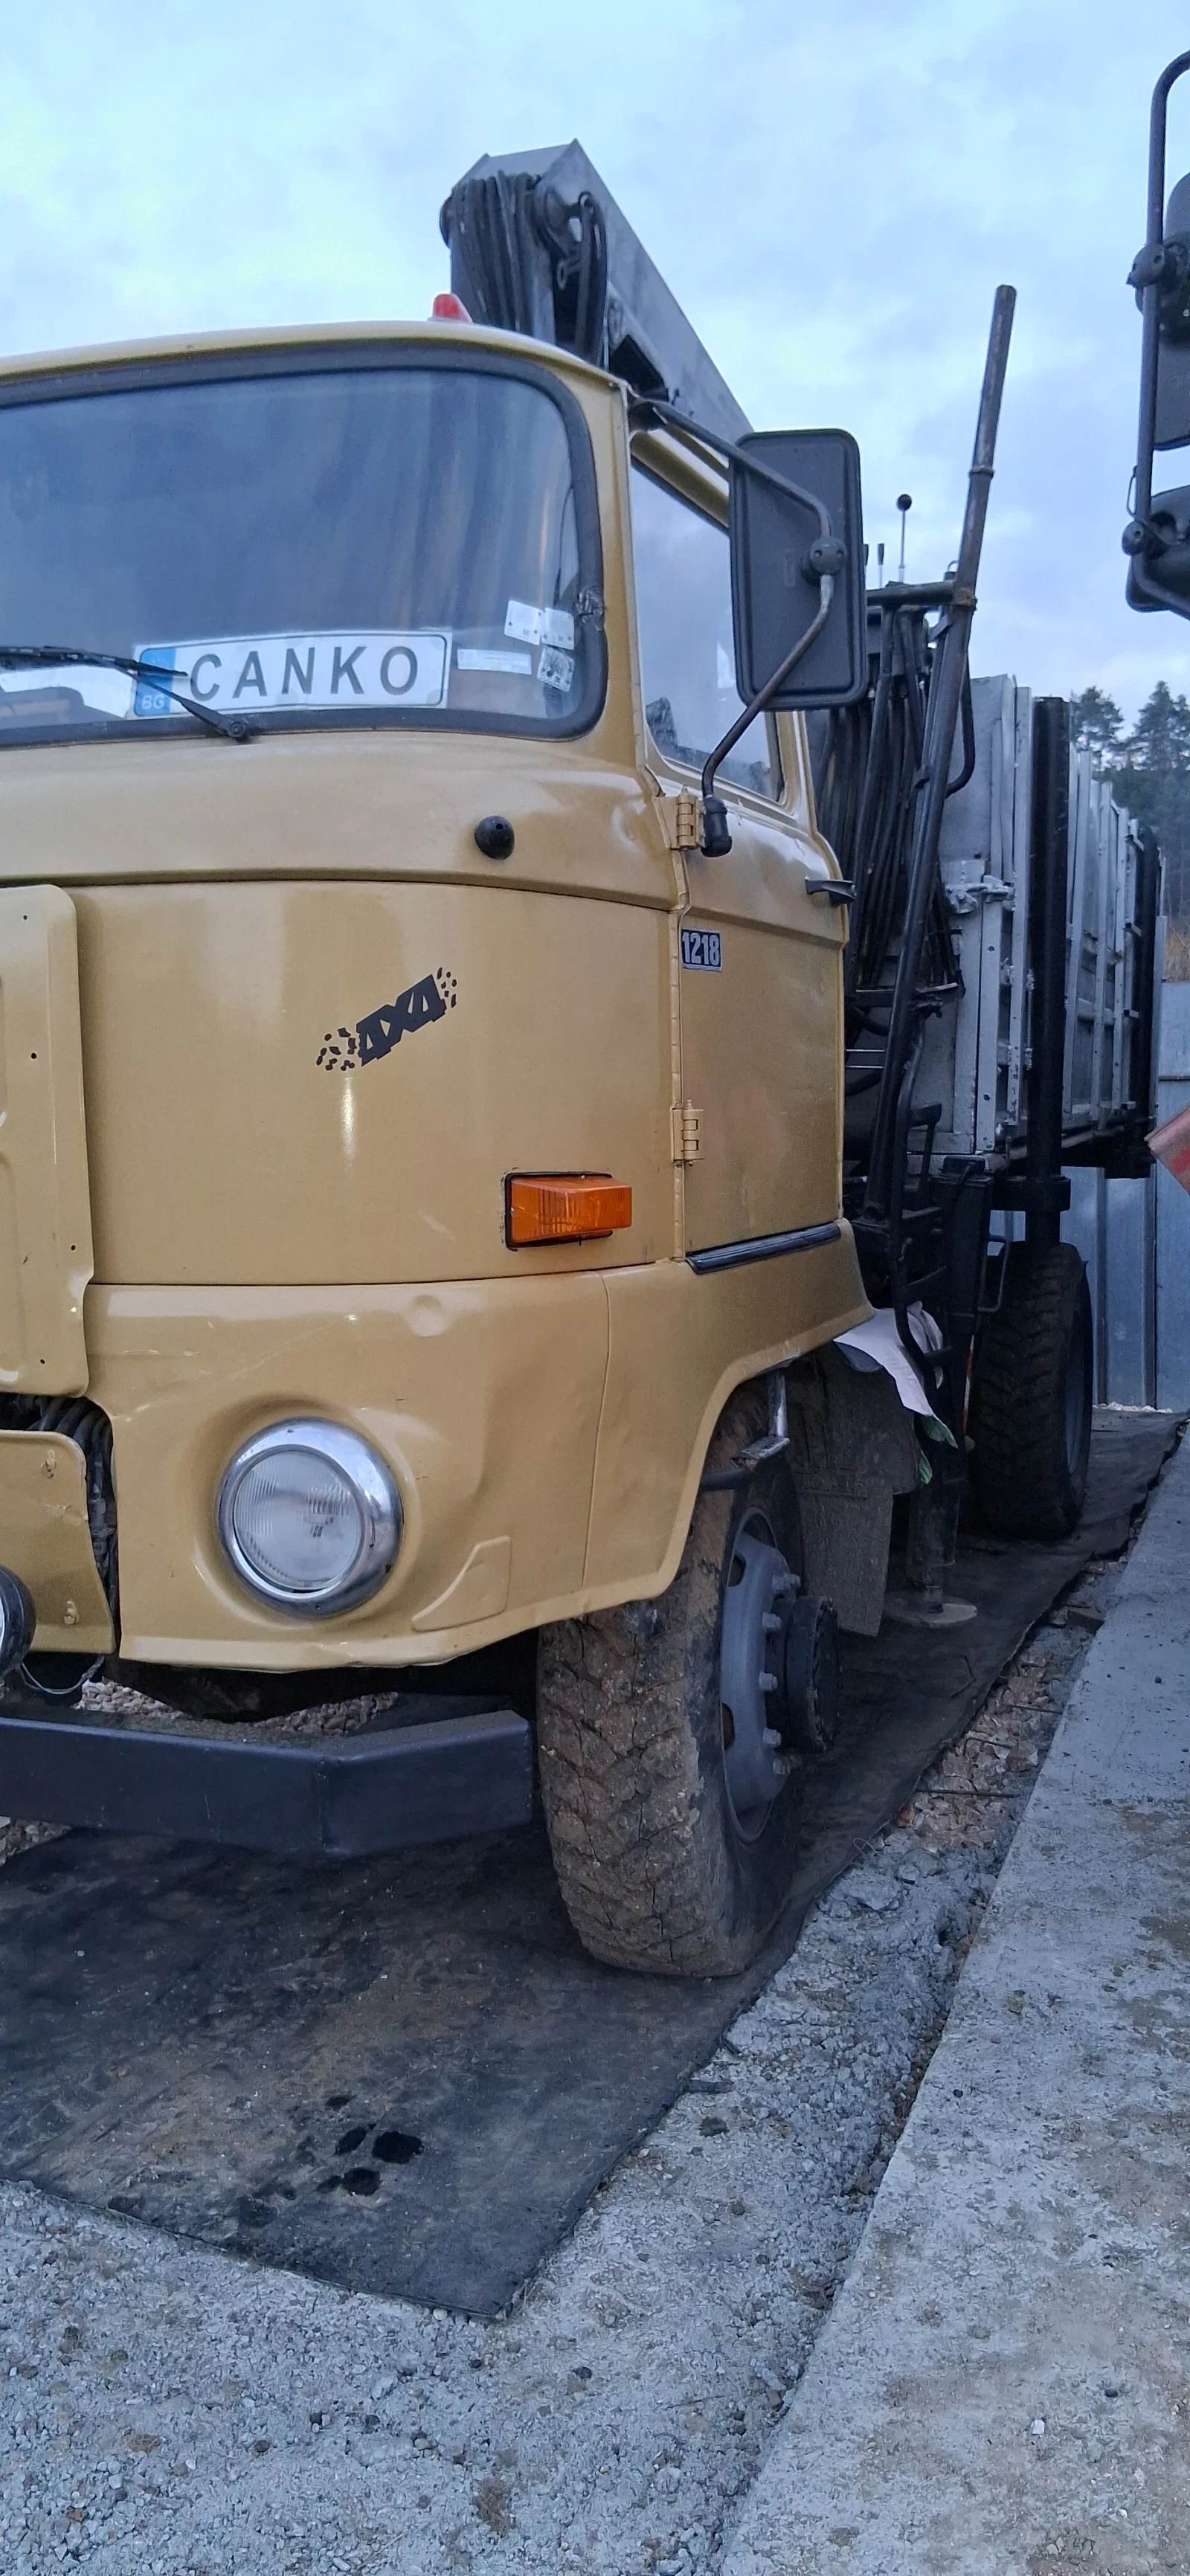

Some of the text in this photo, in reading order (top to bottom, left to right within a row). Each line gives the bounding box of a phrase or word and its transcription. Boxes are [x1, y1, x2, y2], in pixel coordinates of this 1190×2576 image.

[190, 645, 418, 702] CANKO
[141, 695, 165, 710] BG
[681, 931, 720, 966] 1218
